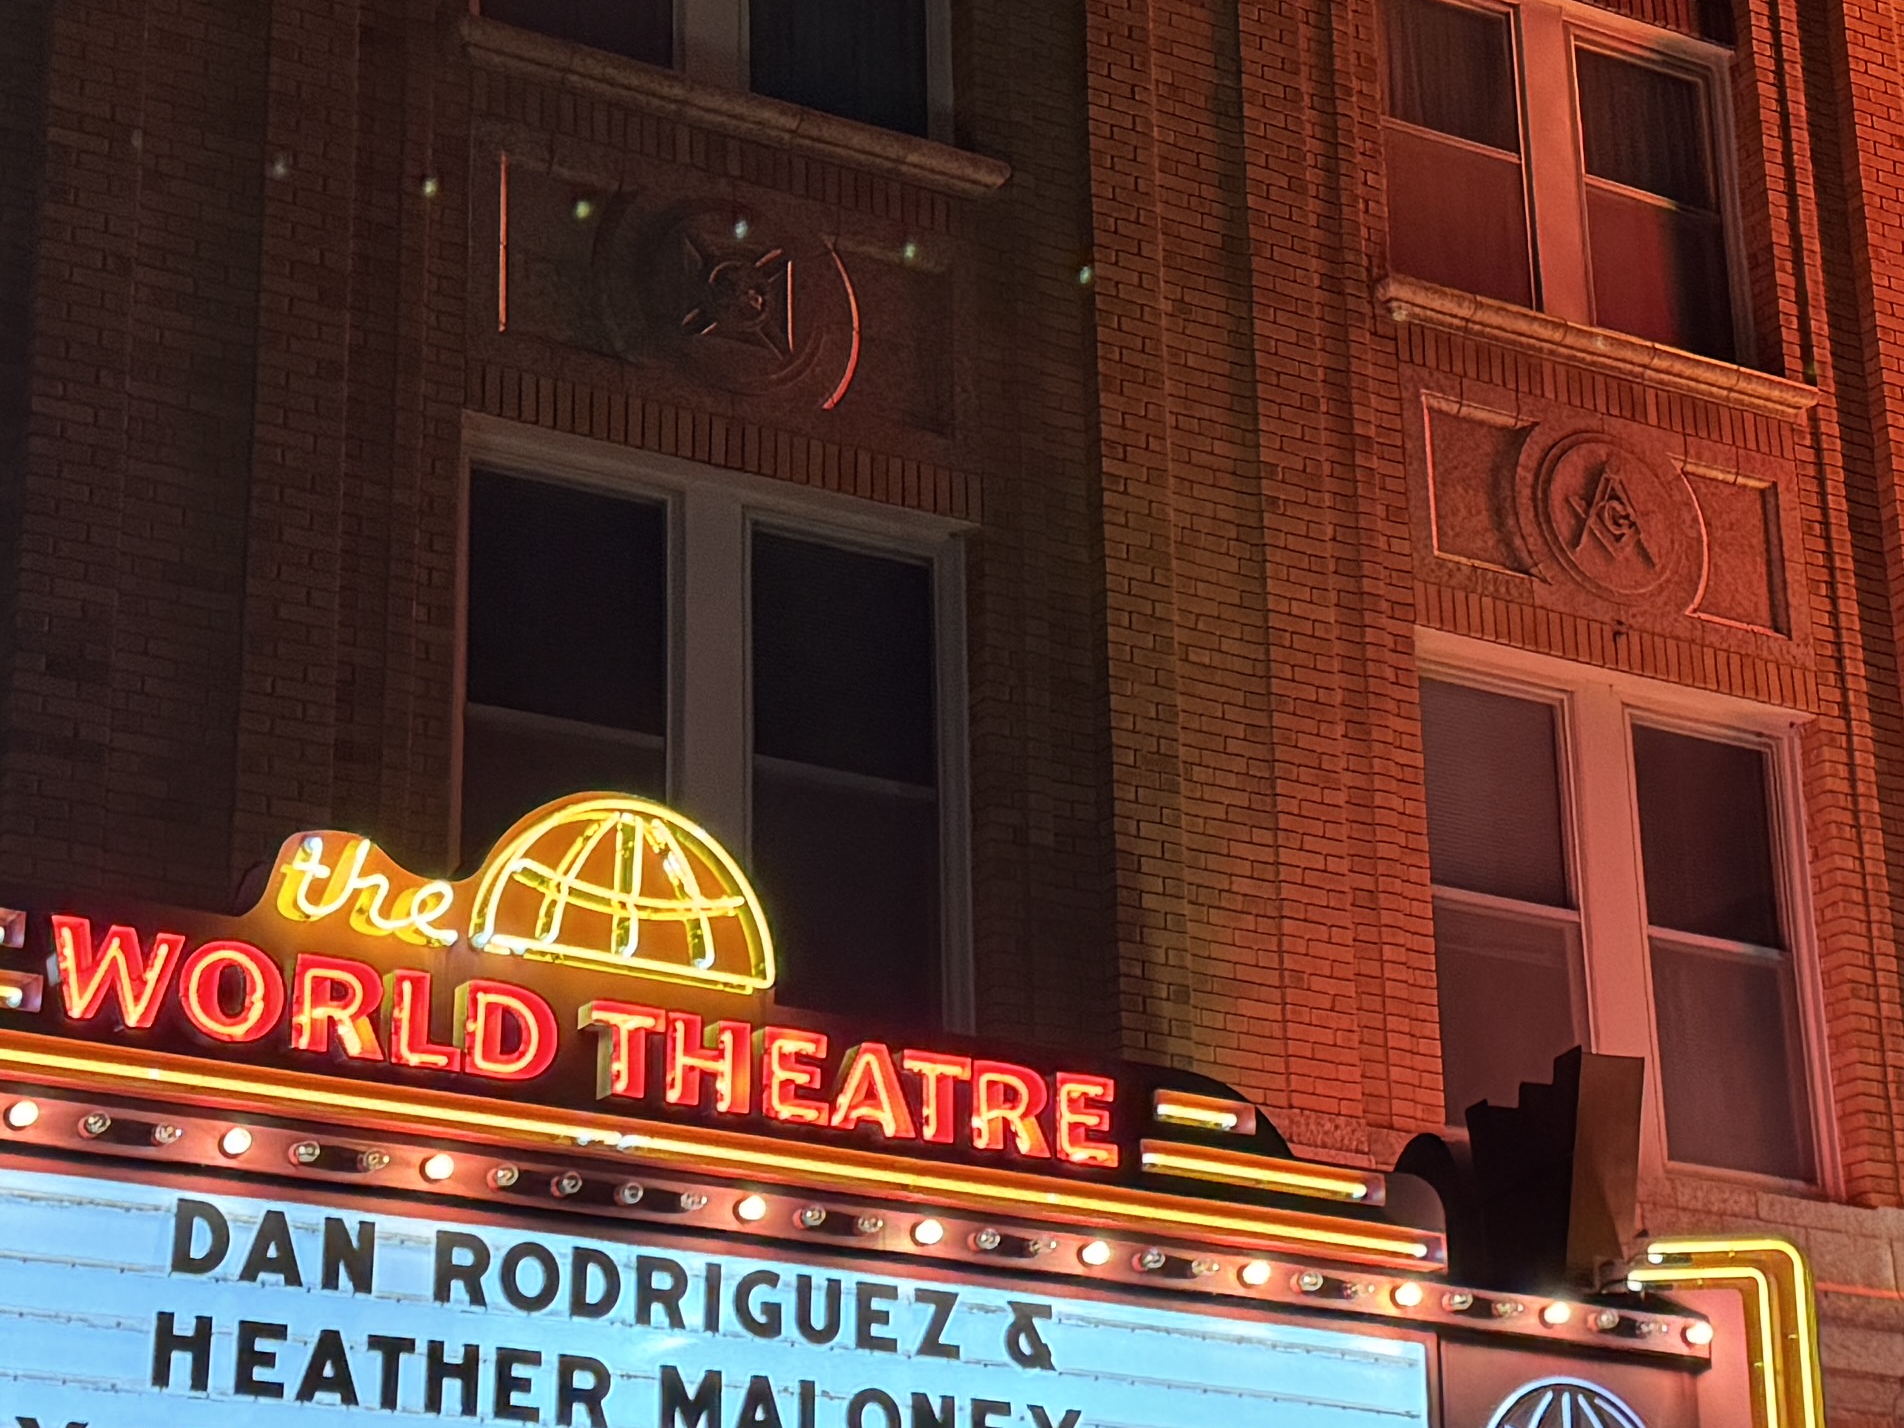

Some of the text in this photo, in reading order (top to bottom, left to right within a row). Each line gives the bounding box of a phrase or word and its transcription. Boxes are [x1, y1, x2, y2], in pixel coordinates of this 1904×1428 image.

[278, 833, 460, 948] the
[51, 913, 1120, 1170] WORLD THEATRE
[169, 1197, 1054, 1372] DAN RODRIGUEZ &
